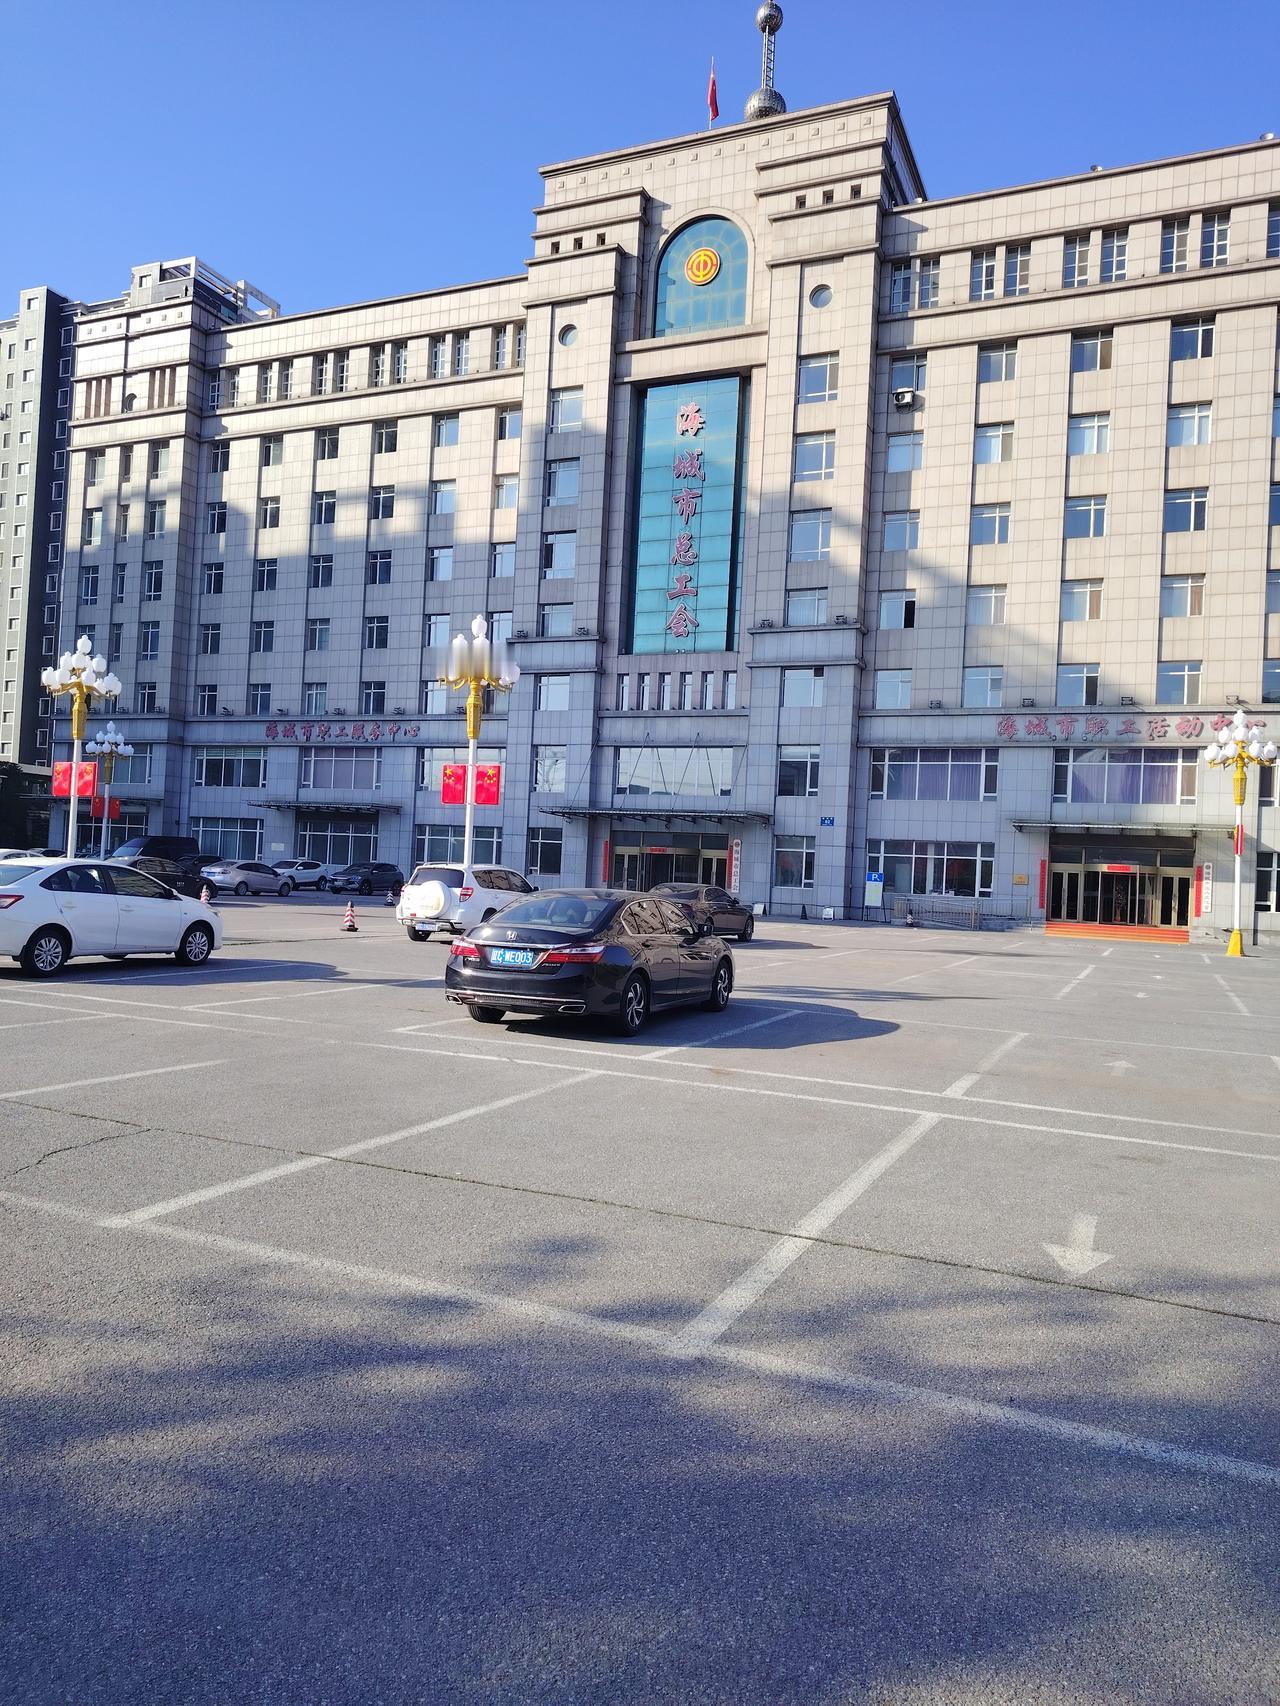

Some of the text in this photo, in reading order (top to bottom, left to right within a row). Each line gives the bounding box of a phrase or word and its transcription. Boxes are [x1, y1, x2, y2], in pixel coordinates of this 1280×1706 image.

[666, 401, 705, 638] 海城市总工会
[265, 721, 420, 743] 海城市职工服务中心
